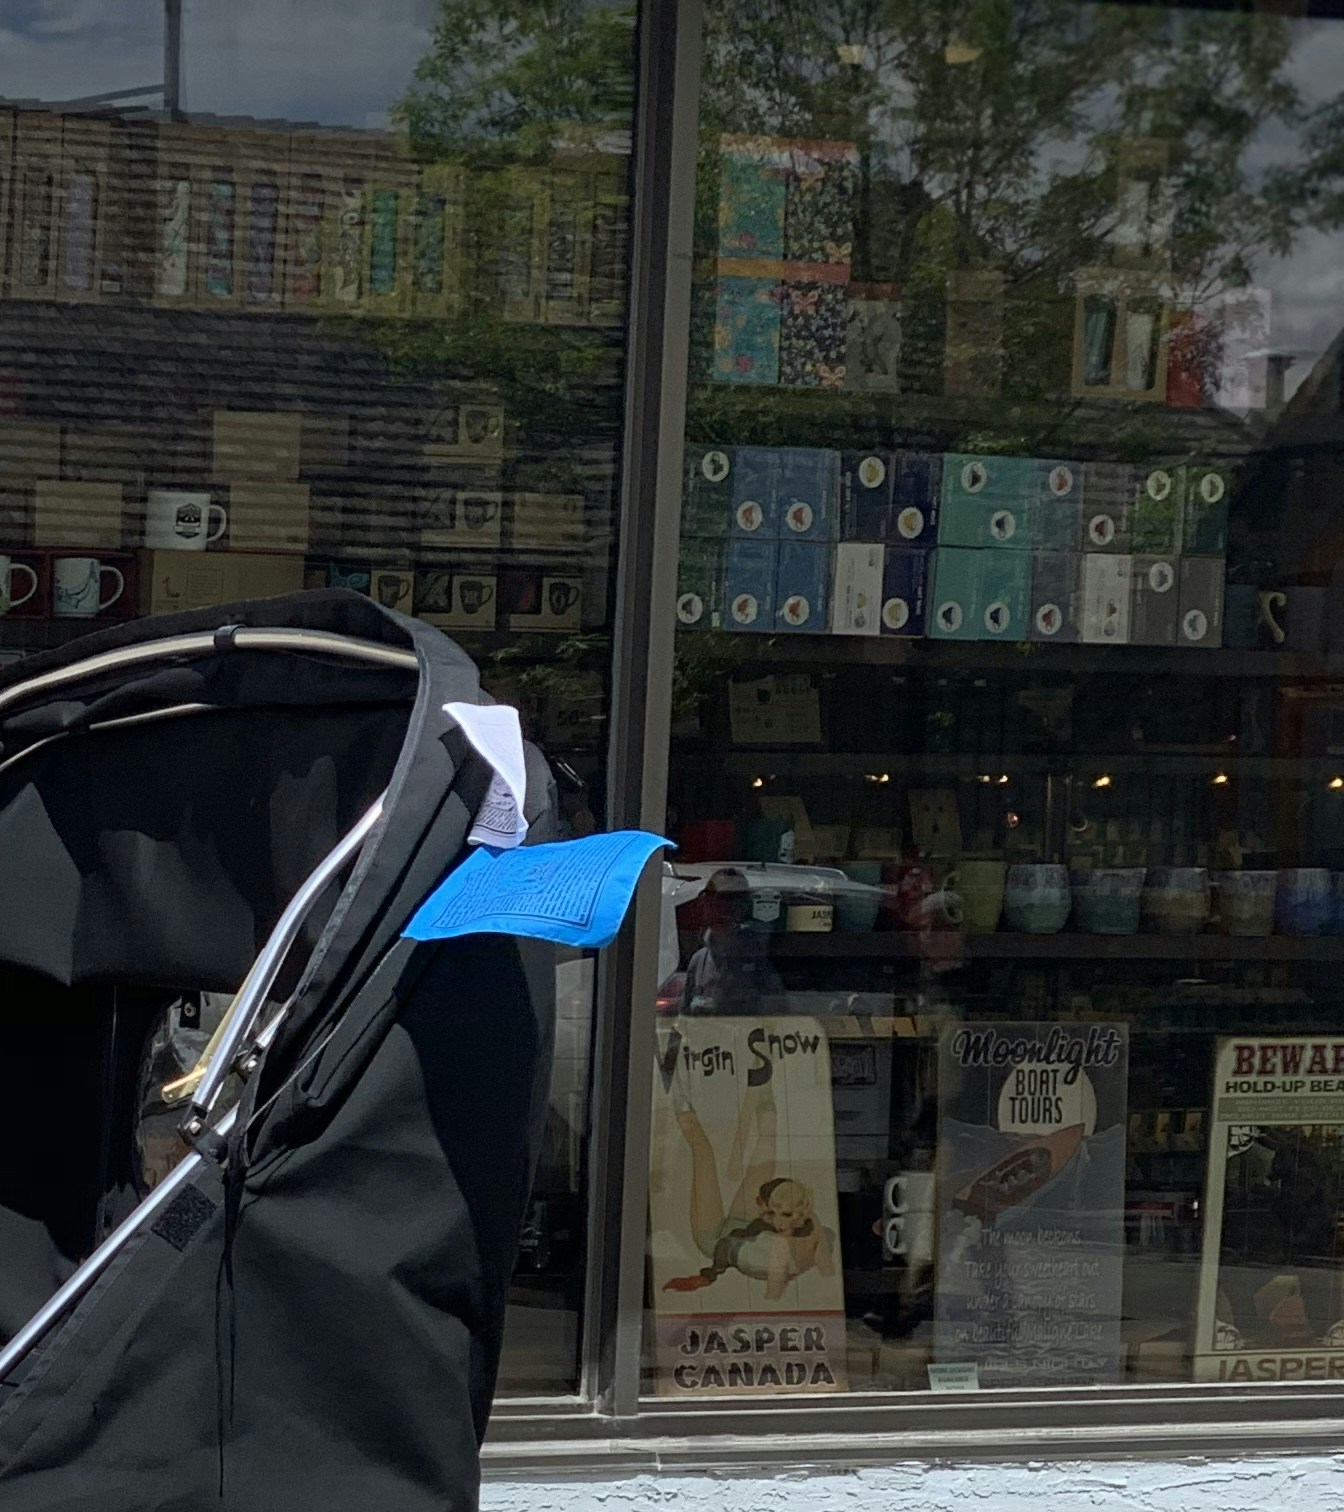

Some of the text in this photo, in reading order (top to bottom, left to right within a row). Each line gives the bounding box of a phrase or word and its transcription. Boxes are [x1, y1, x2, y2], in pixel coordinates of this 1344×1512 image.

[655, 1027, 734, 1095] Virgin
[748, 1028, 820, 1087] Snow
[952, 1026, 1121, 1085] Moonlight
[1015, 1069, 1060, 1096] BOAT
[1225, 1081, 1306, 1093] HOLD-UP
[1009, 1097, 1063, 1124] TOURS
[680, 1326, 827, 1354] JASPER
[674, 1362, 836, 1389] CANADA
